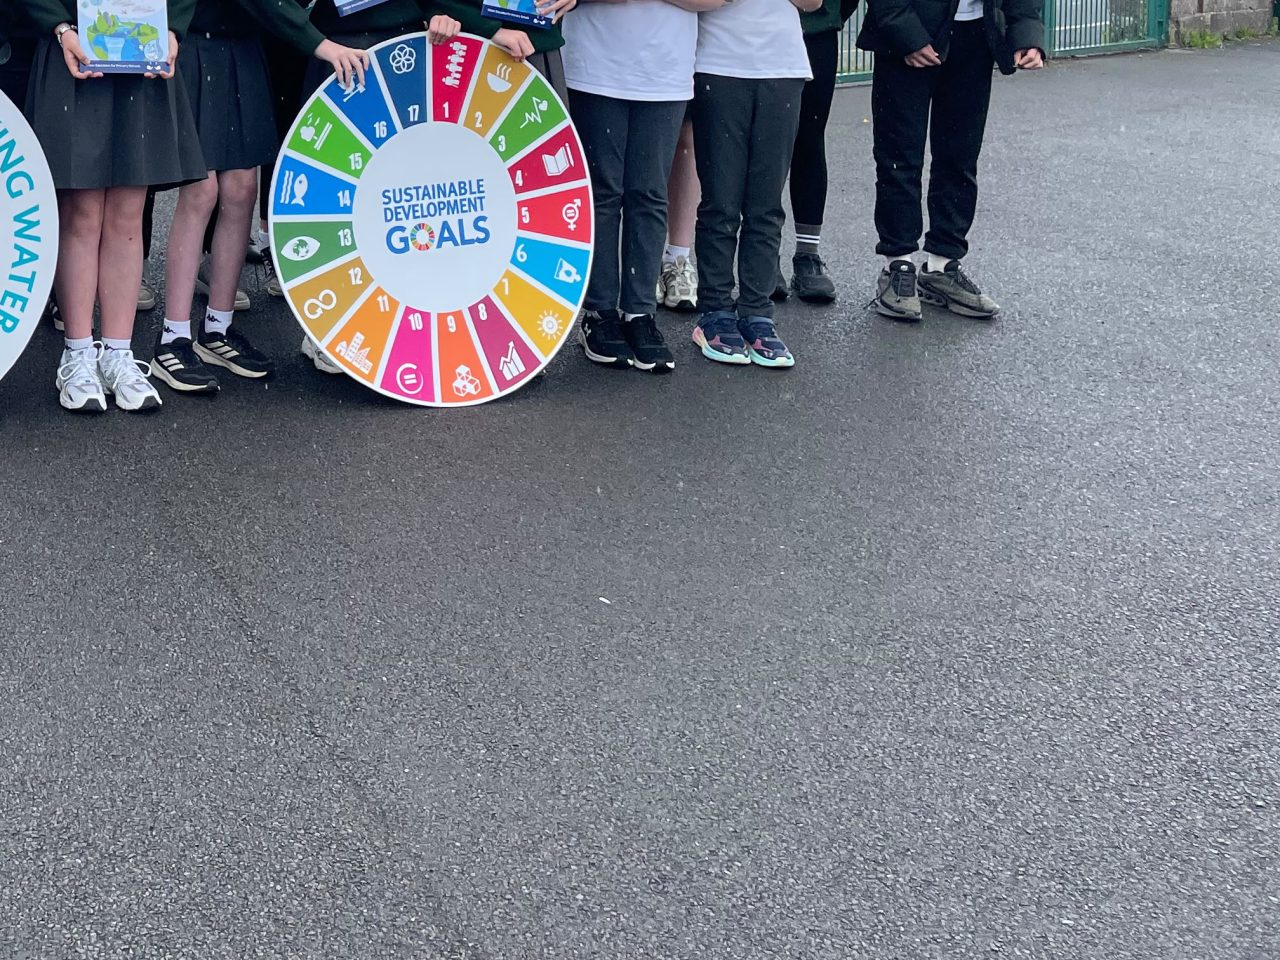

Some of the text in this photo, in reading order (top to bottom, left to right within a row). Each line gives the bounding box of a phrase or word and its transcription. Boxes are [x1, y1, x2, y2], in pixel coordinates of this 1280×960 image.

[407, 104, 420, 122] 17
[442, 101, 449, 118] 1
[475, 111, 483, 128] 2
[373, 121, 388, 138] 16
[498, 135, 506, 152] 3
[348, 152, 363, 170] 15
[515, 170, 523, 187] 4
[337, 189, 351, 208] 14
[381, 178, 485, 205] SUSTAINABLE
[383, 196, 485, 223] DEVELOPMENT
[521, 207, 530, 223] 5
[337, 228, 352, 247] 13
[385, 215, 491, 255] GOALS
[516, 243, 527, 262] 6
[348, 266, 363, 285] 12
[502, 277, 510, 295] 7
[377, 294, 390, 313] 11
[477, 302, 488, 321] 8
[408, 312, 423, 331] 10
[447, 314, 457, 333] 9
